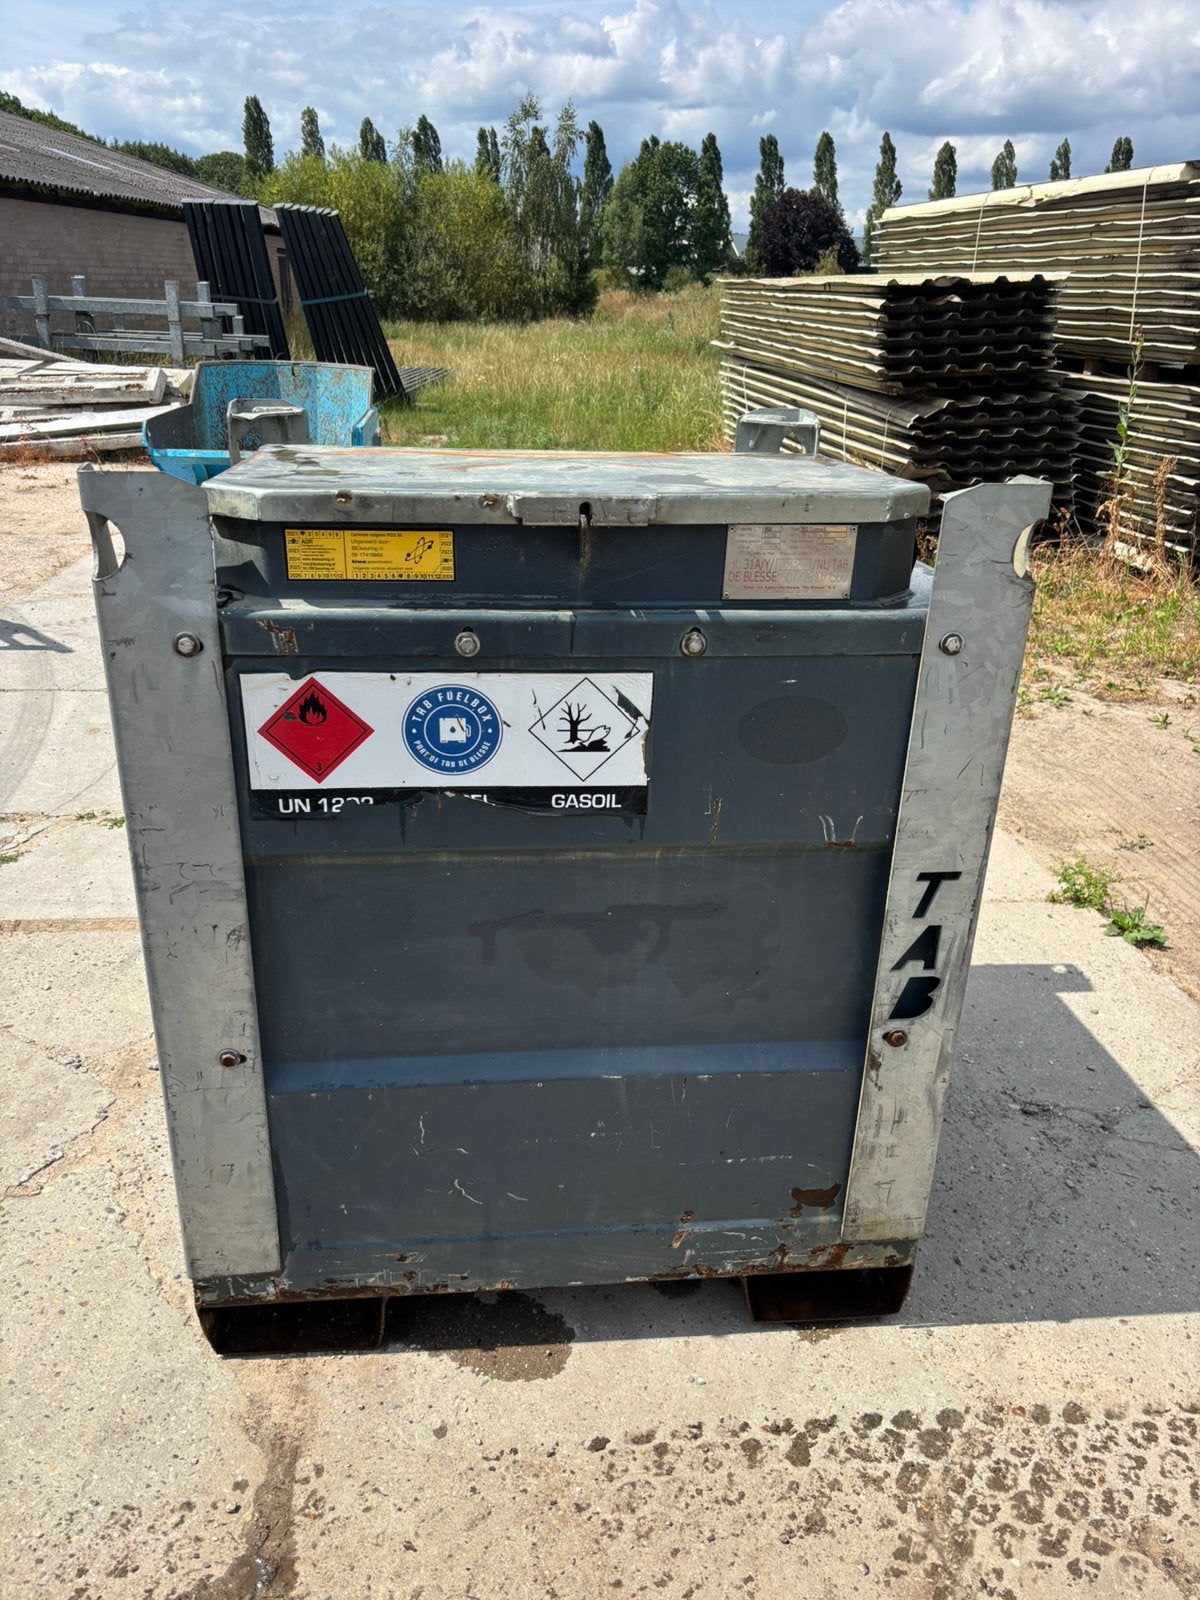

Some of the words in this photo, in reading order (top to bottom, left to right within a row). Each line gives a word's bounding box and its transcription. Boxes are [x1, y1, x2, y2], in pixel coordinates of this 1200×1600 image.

[728, 571, 741, 583] DE
[411, 699, 433, 722] TAB
[437, 690, 493, 722] FUELBOX
[413, 739, 430, 757] PART
[428, 756, 440, 764] OF
[441, 759, 456, 768] TAB
[458, 758, 469, 767] DE
[470, 741, 491, 763] BLESSE
[315, 762, 322, 772] 3
[278, 798, 311, 814] UN
[550, 793, 623, 809] GASOIL
[888, 871, 962, 1020] TAB
